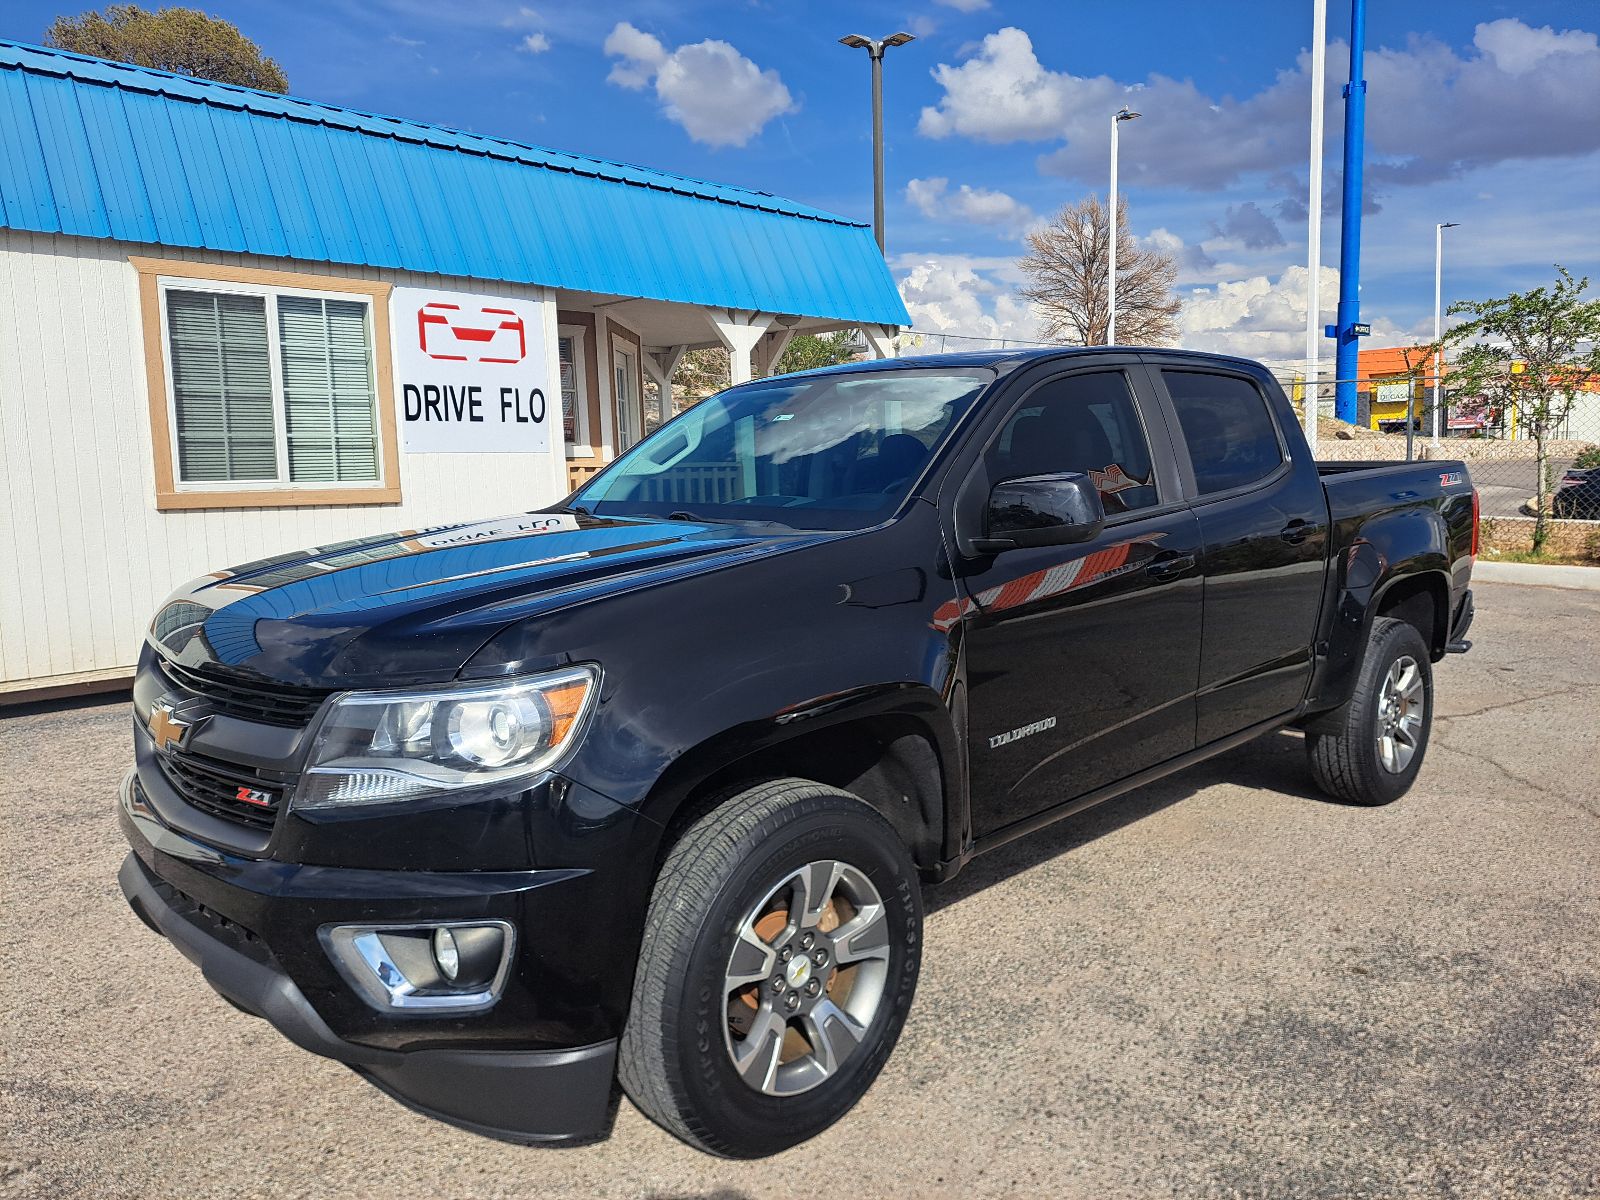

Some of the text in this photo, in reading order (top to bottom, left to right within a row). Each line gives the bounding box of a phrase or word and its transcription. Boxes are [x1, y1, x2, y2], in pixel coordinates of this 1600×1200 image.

[403, 384, 545, 423] DRIVE FLO
[1439, 472, 1462, 487] Z71
[989, 716, 1057, 749] COLORADO
[236, 787, 272, 806] Z71
